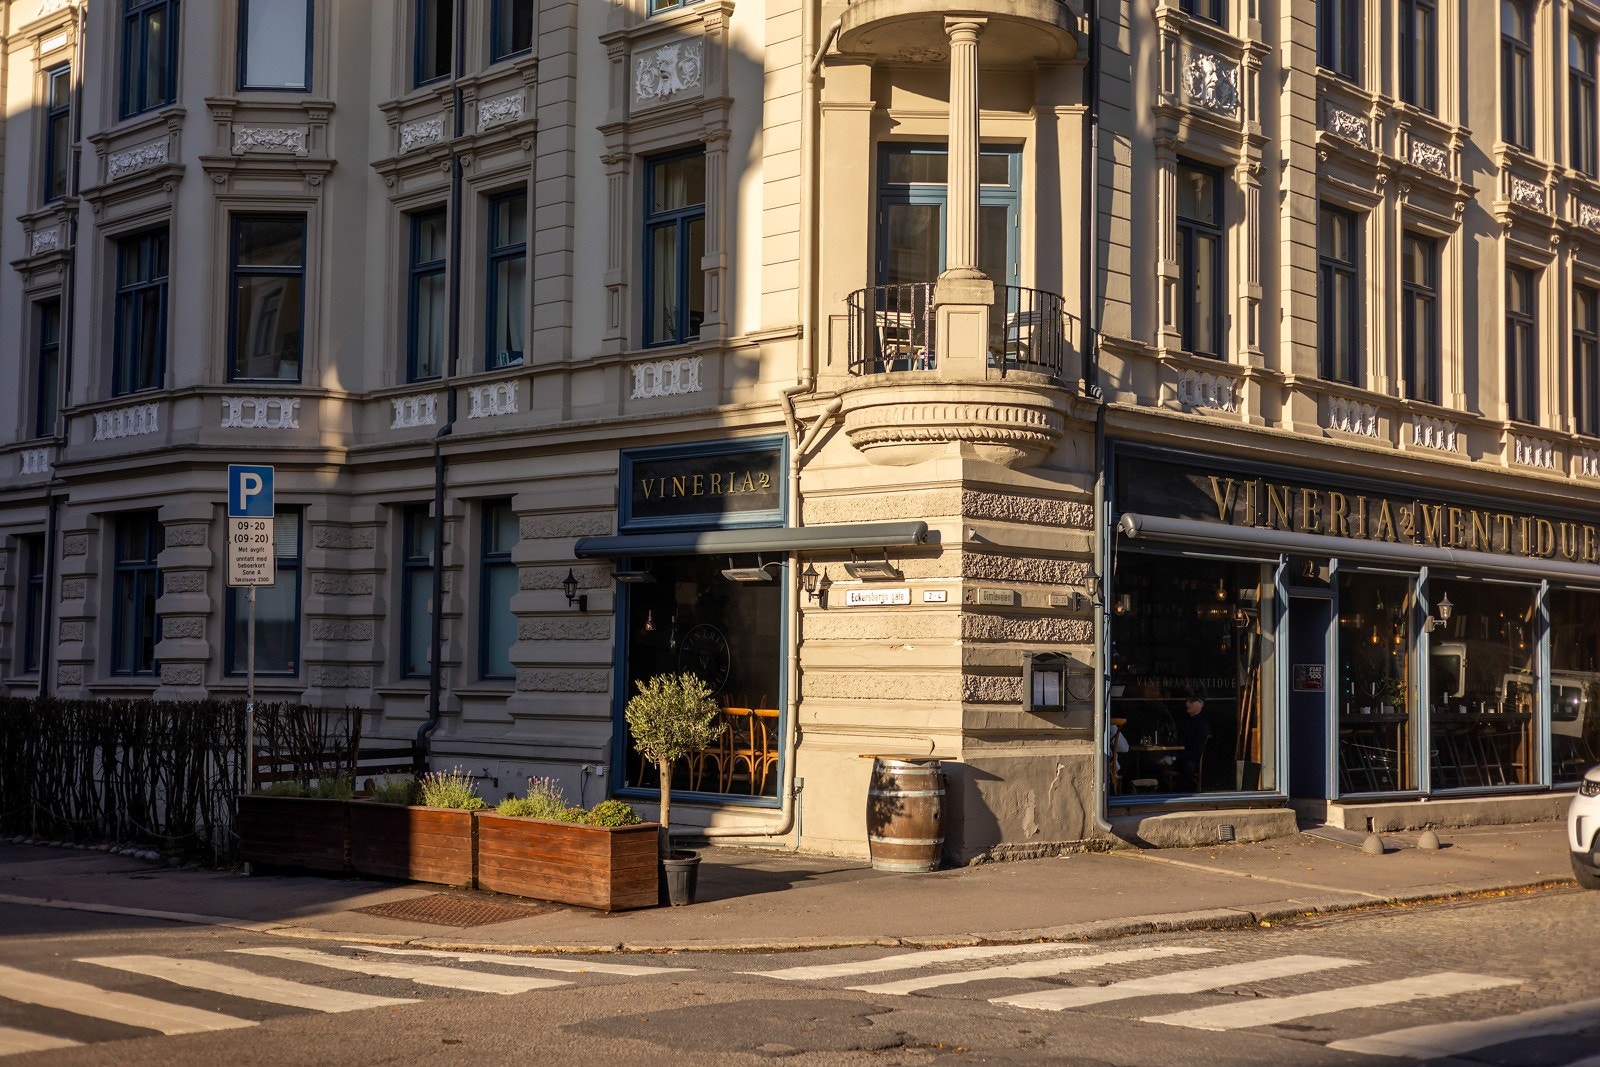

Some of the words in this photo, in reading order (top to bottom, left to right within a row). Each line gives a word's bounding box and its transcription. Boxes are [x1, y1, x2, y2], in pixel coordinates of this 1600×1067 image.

[240, 472, 263, 510] P
[1208, 475, 1397, 540] VINERIA
[1420, 503, 1597, 560] VENTIDUE
